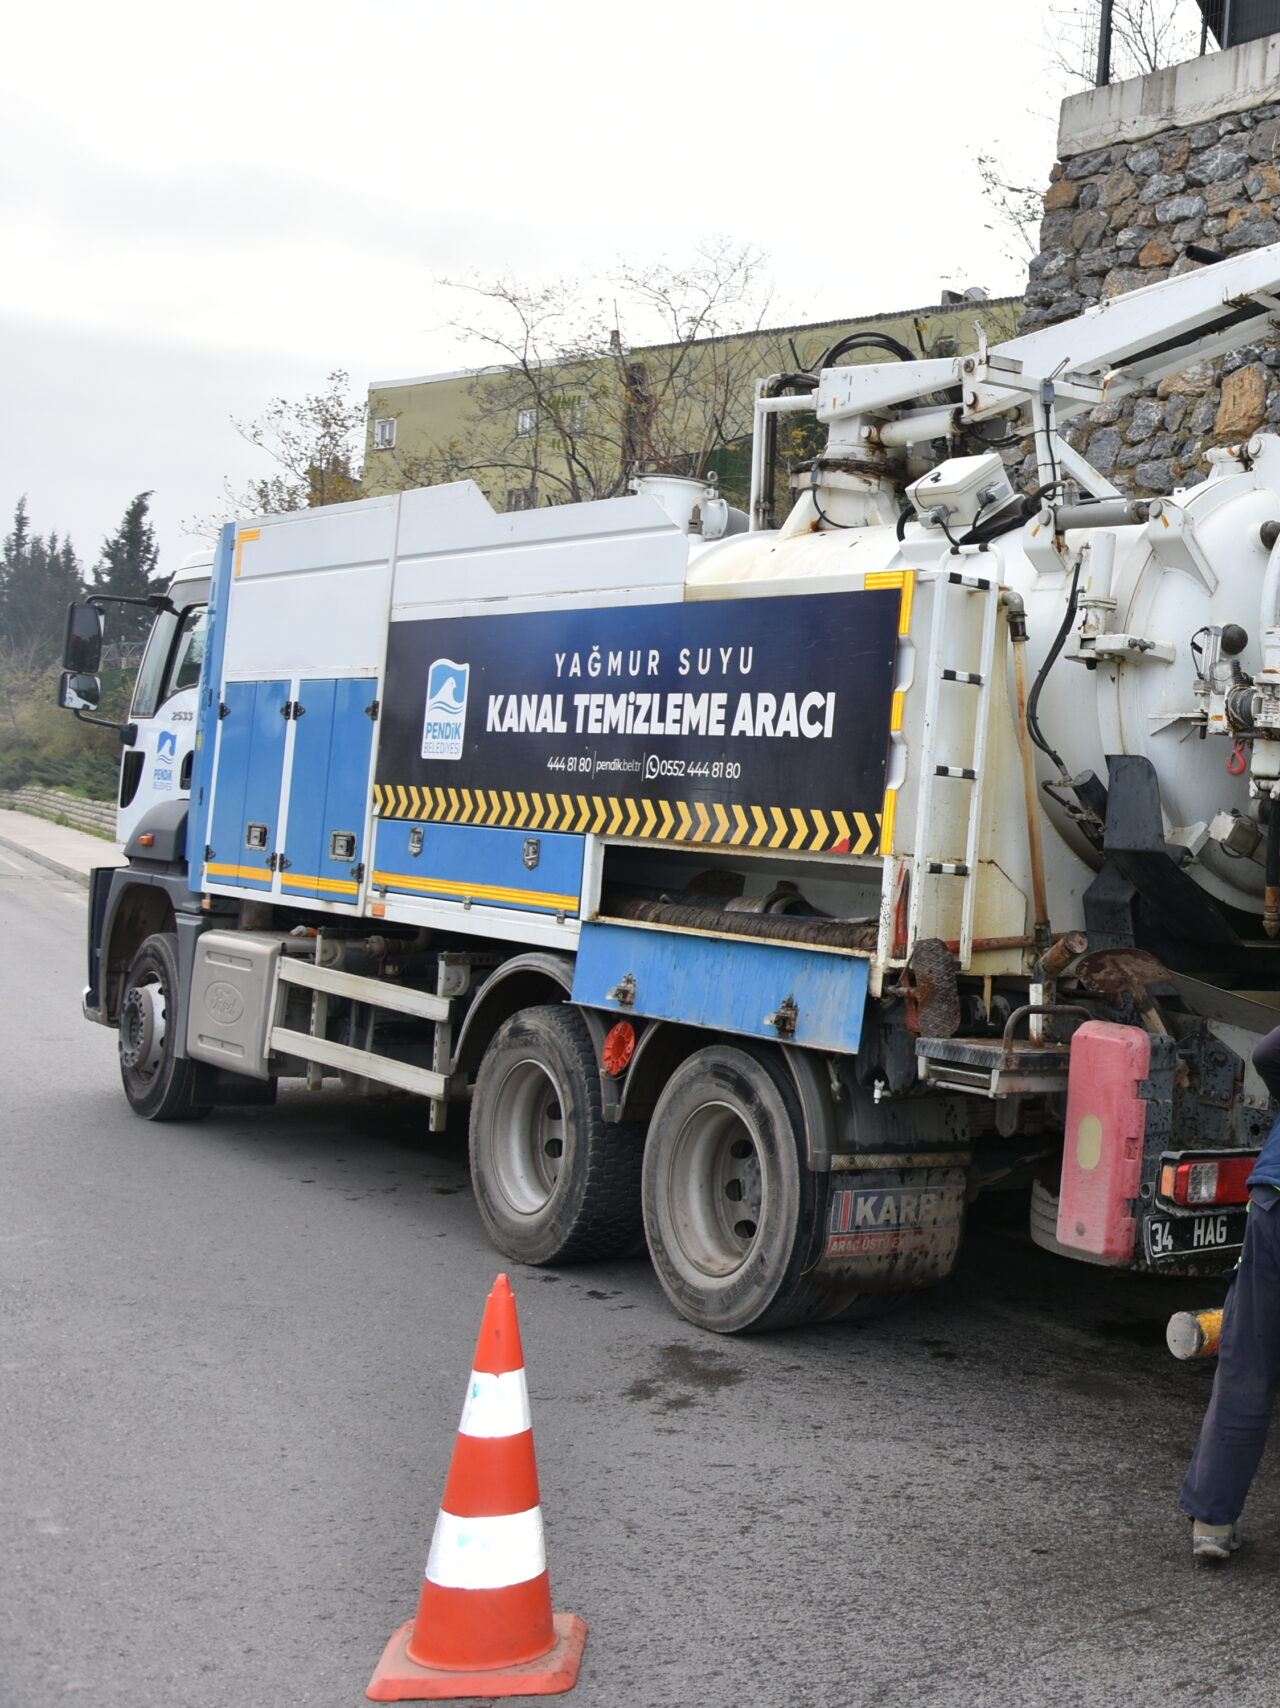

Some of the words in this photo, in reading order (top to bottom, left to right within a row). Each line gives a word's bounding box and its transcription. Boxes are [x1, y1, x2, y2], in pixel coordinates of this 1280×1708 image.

[555, 645, 660, 678] YAĞMUR
[678, 646, 753, 676] SUYU
[171, 711, 194, 721] 2533
[486, 694, 568, 733] KANAL
[731, 691, 836, 739] ARACI
[547, 756, 566, 771] 444
[566, 757, 577, 772] 81
[578, 757, 592, 773] 80
[660, 760, 686, 777] 0552
[687, 761, 710, 778] 444
[711, 762, 723, 778] 81
[725, 762, 741, 779] 80
[1151, 1221, 1174, 1252] 34
[1193, 1215, 1227, 1247] HAG
